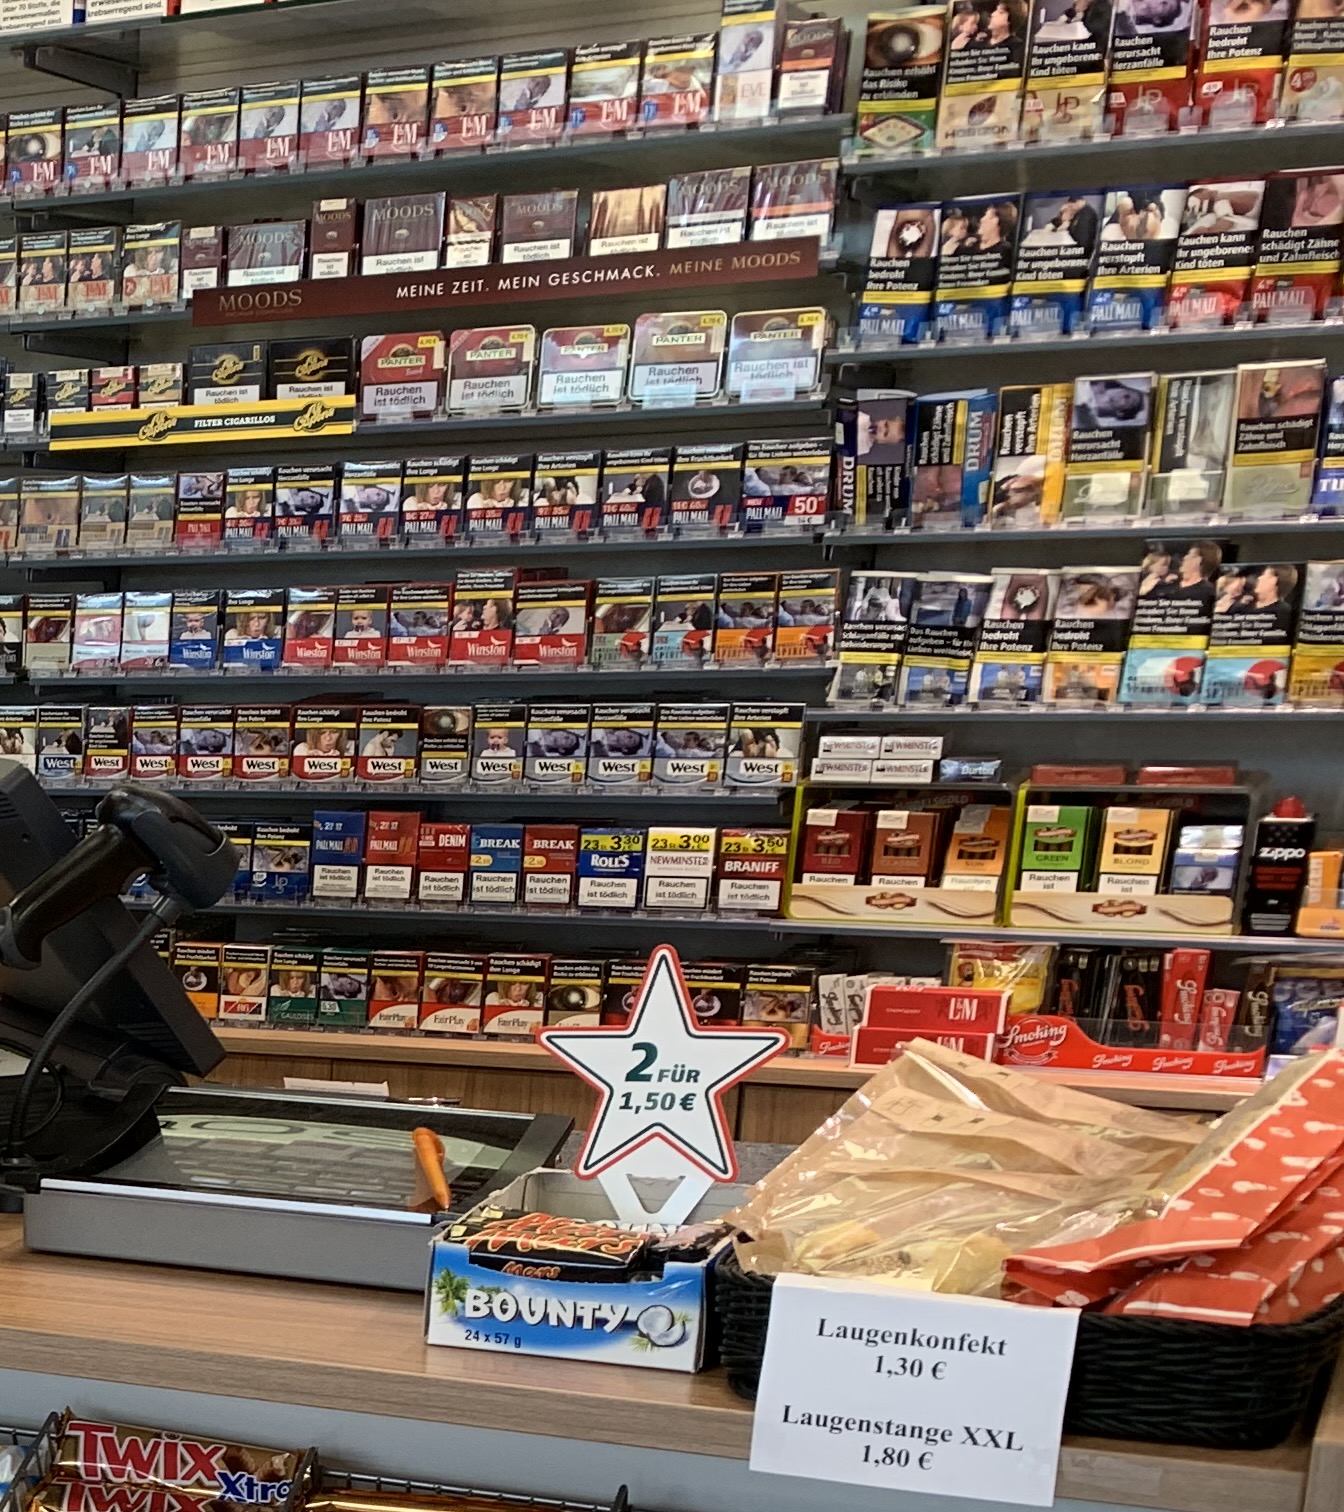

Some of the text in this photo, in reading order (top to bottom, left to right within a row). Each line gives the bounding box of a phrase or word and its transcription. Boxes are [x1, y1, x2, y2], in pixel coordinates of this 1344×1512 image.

[1209, 24, 1252, 37] Rauchen
[1232, 46, 1263, 59] Potenz
[373, 203, 434, 220] MOODS
[396, 251, 801, 299] MEINE ZEIT. MEIN GESCHMACK. MEINE MOODS
[218, 288, 303, 312] MOODS
[379, 355, 426, 368] PANTER
[467, 348, 513, 361] PANTER
[373, 393, 427, 406] ist tödlich
[375, 386, 423, 398] Rauchen
[194, 415, 275, 429] FILTER CIGARILLOS
[965, 410, 982, 472] DRUM
[467, 643, 506, 657] Winston
[370, 760, 403, 773] West
[427, 760, 459, 772] West
[438, 832, 466, 848] DENIM
[480, 838, 520, 849] BREAK
[532, 838, 574, 850] BREAK
[1259, 845, 1306, 861] zippo
[725, 859, 780, 873] BRANIFF
[591, 880, 627, 890] Rauchen
[587, 890, 627, 900] ist tödlich
[948, 998, 978, 1022] L&M
[1007, 1021, 1069, 1052] Smoking
[624, 1041, 700, 1083] 2 FÜR
[464, 1289, 624, 1332] BOUNTY
[464, 1329, 521, 1348] 24 x 57 g
[816, 1318, 1008, 1357] Laugenkonfekt
[874, 1355, 947, 1381] 1,30 €
[782, 1404, 1024, 1452] Laugenstange XXL
[861, 1445, 933, 1471] 1,80 €
[216, 1471, 292, 1504] Xtra
